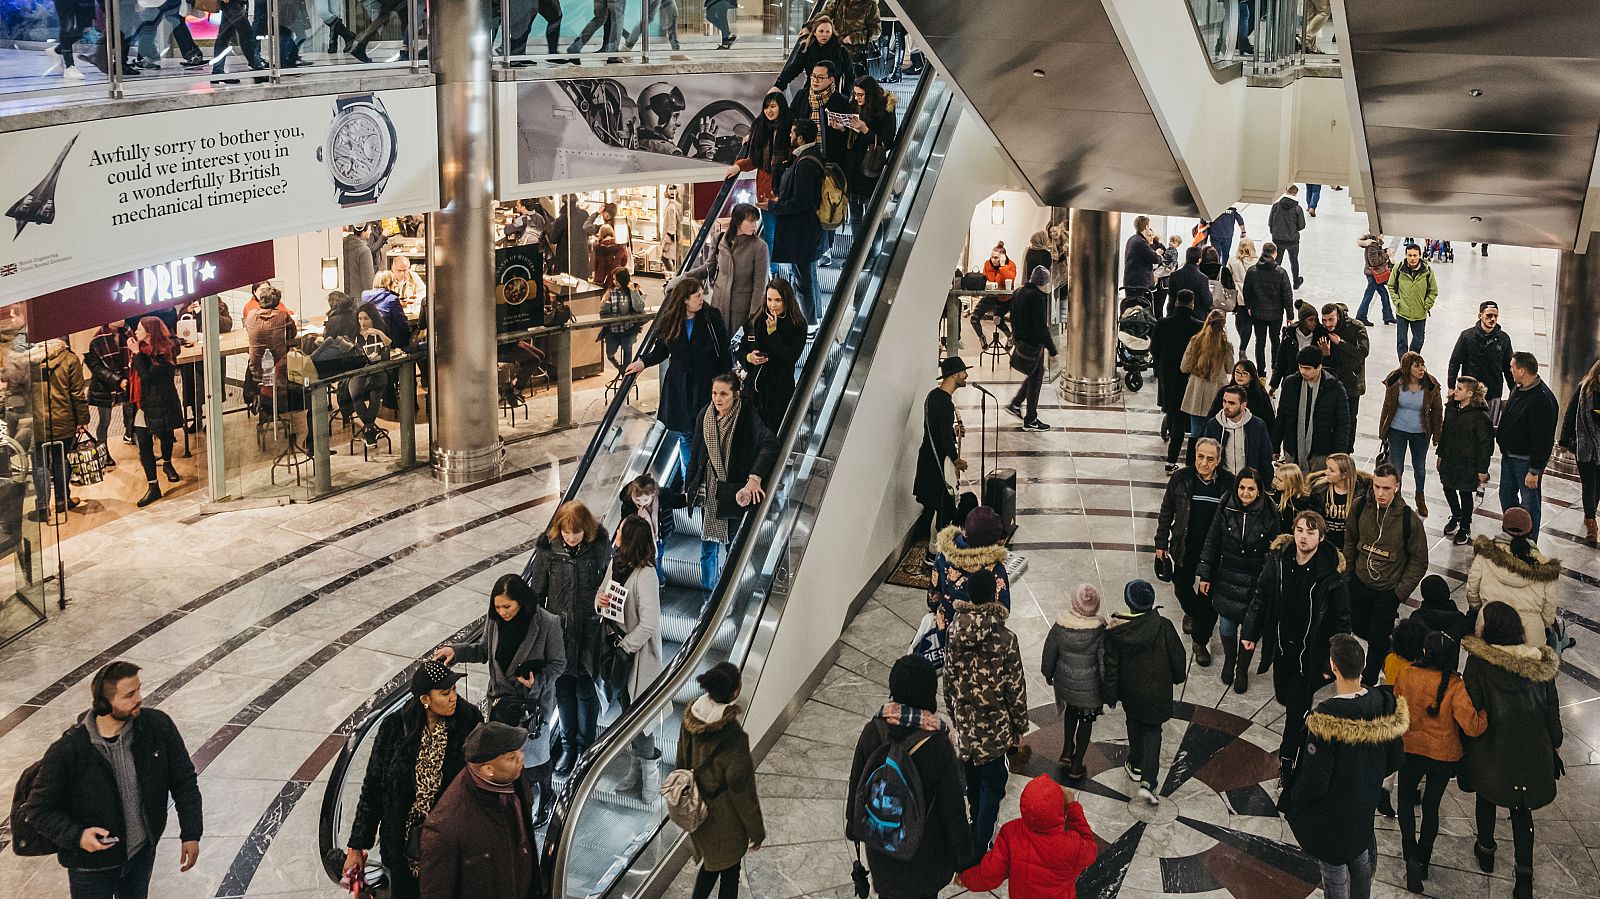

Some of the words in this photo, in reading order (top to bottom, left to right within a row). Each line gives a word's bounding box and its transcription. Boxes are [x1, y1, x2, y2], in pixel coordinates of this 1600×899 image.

[89, 143, 150, 167] Awfully
[154, 140, 196, 156] sorry
[200, 137, 216, 149] to
[219, 129, 270, 147] bother
[273, 127, 305, 143] you,
[107, 162, 152, 185] could
[155, 162, 178, 176] we
[181, 152, 240, 172] interest
[243, 149, 271, 166] you
[274, 143, 289, 158] in
[111, 193, 203, 226] mechanical
[207, 179, 288, 207] timepiece?
[118, 191, 129, 204] a
[132, 172, 225, 200] wonderfully
[228, 162, 281, 184] British
[143, 256, 196, 305] PRET
